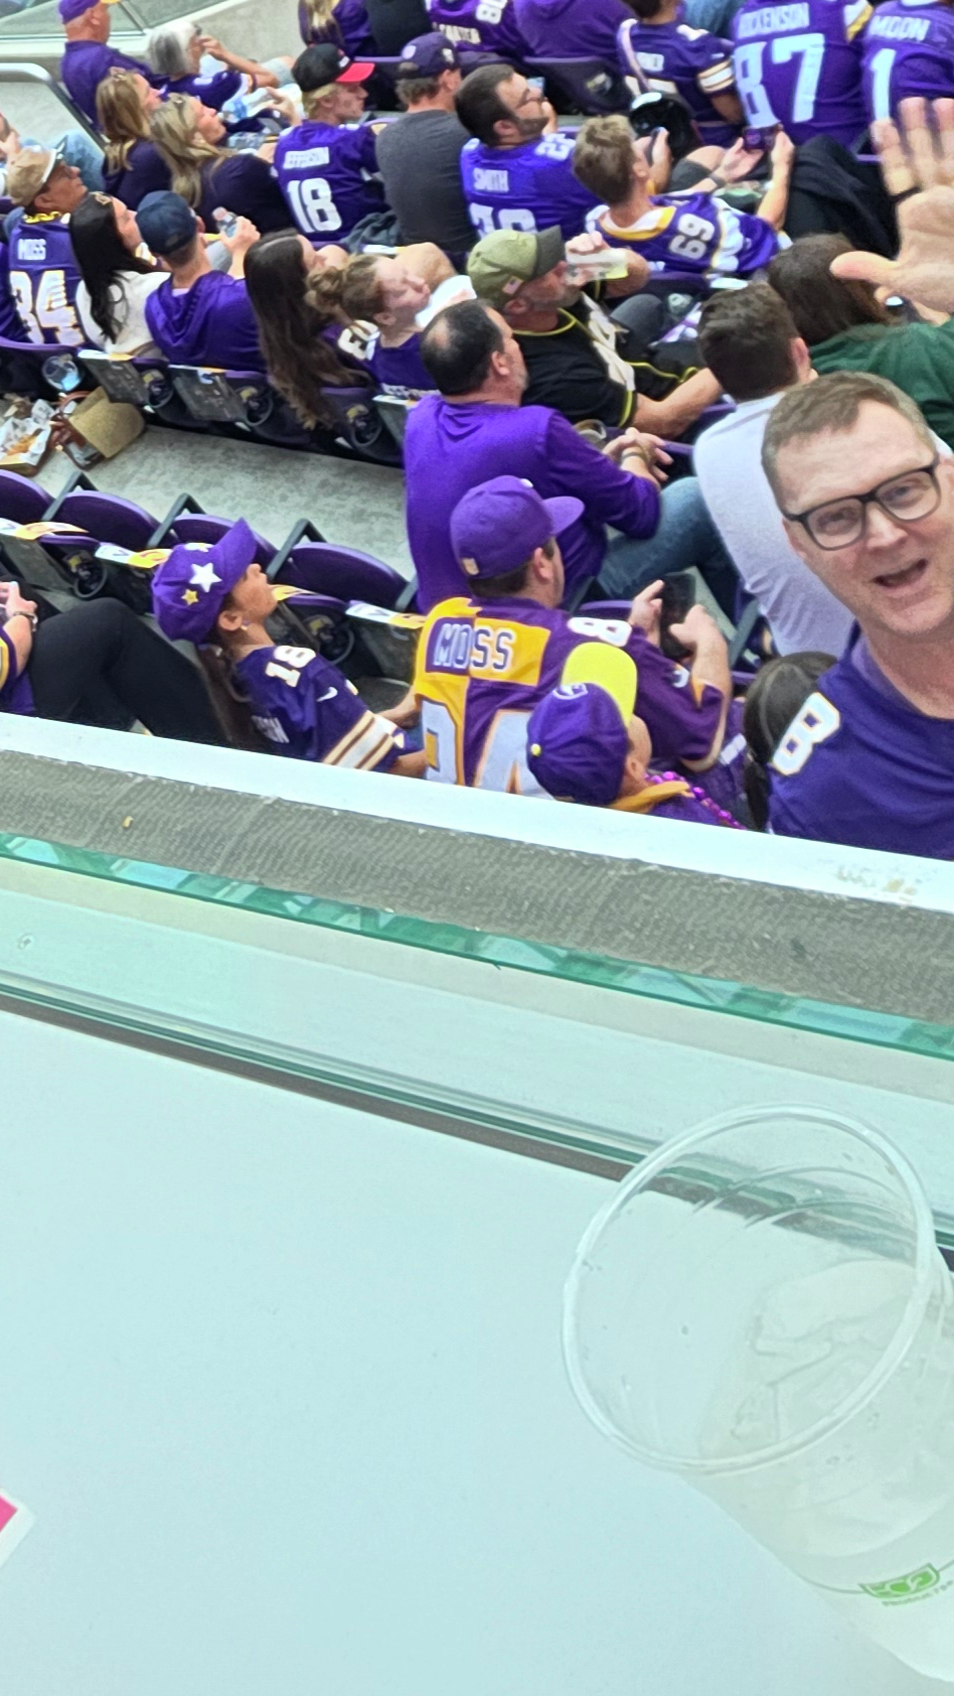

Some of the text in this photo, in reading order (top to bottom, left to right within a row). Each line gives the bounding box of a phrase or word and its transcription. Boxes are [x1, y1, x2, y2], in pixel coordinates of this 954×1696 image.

[869, 14, 932, 43] MOON
[732, 32, 826, 131] 87
[286, 177, 343, 234] 18
[265, 645, 317, 688] 18
[432, 622, 517, 670] MOSS
